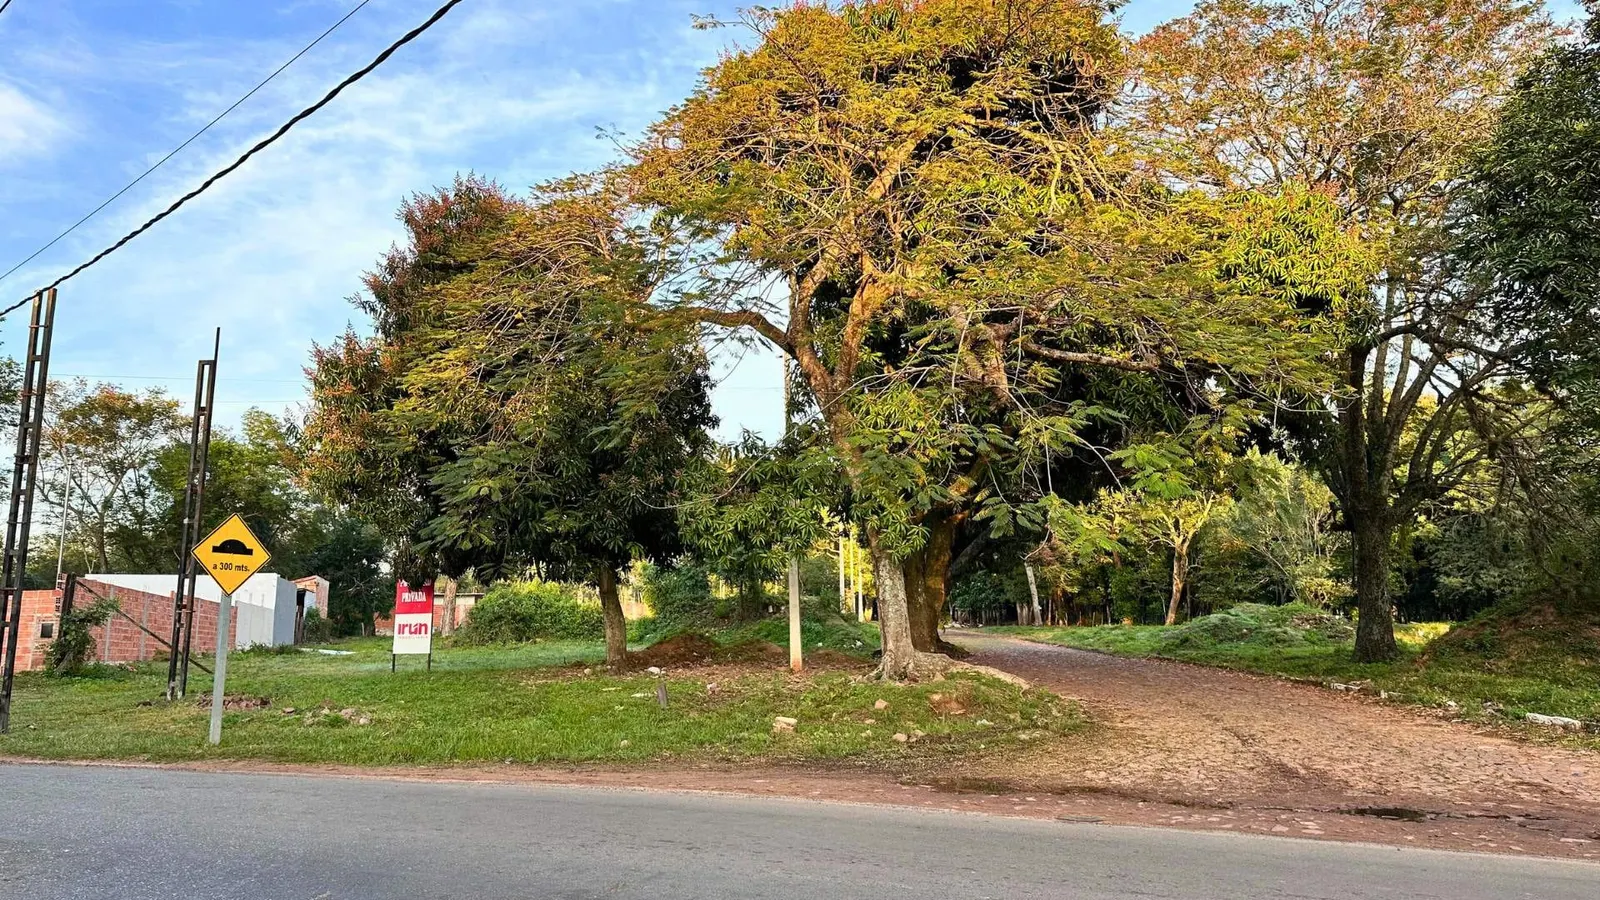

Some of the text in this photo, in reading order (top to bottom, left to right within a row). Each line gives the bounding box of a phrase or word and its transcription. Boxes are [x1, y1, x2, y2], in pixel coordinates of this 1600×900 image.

[219, 562, 233, 571] 300
[234, 564, 250, 572] mts.
[401, 591, 427, 603] PRIVADA
